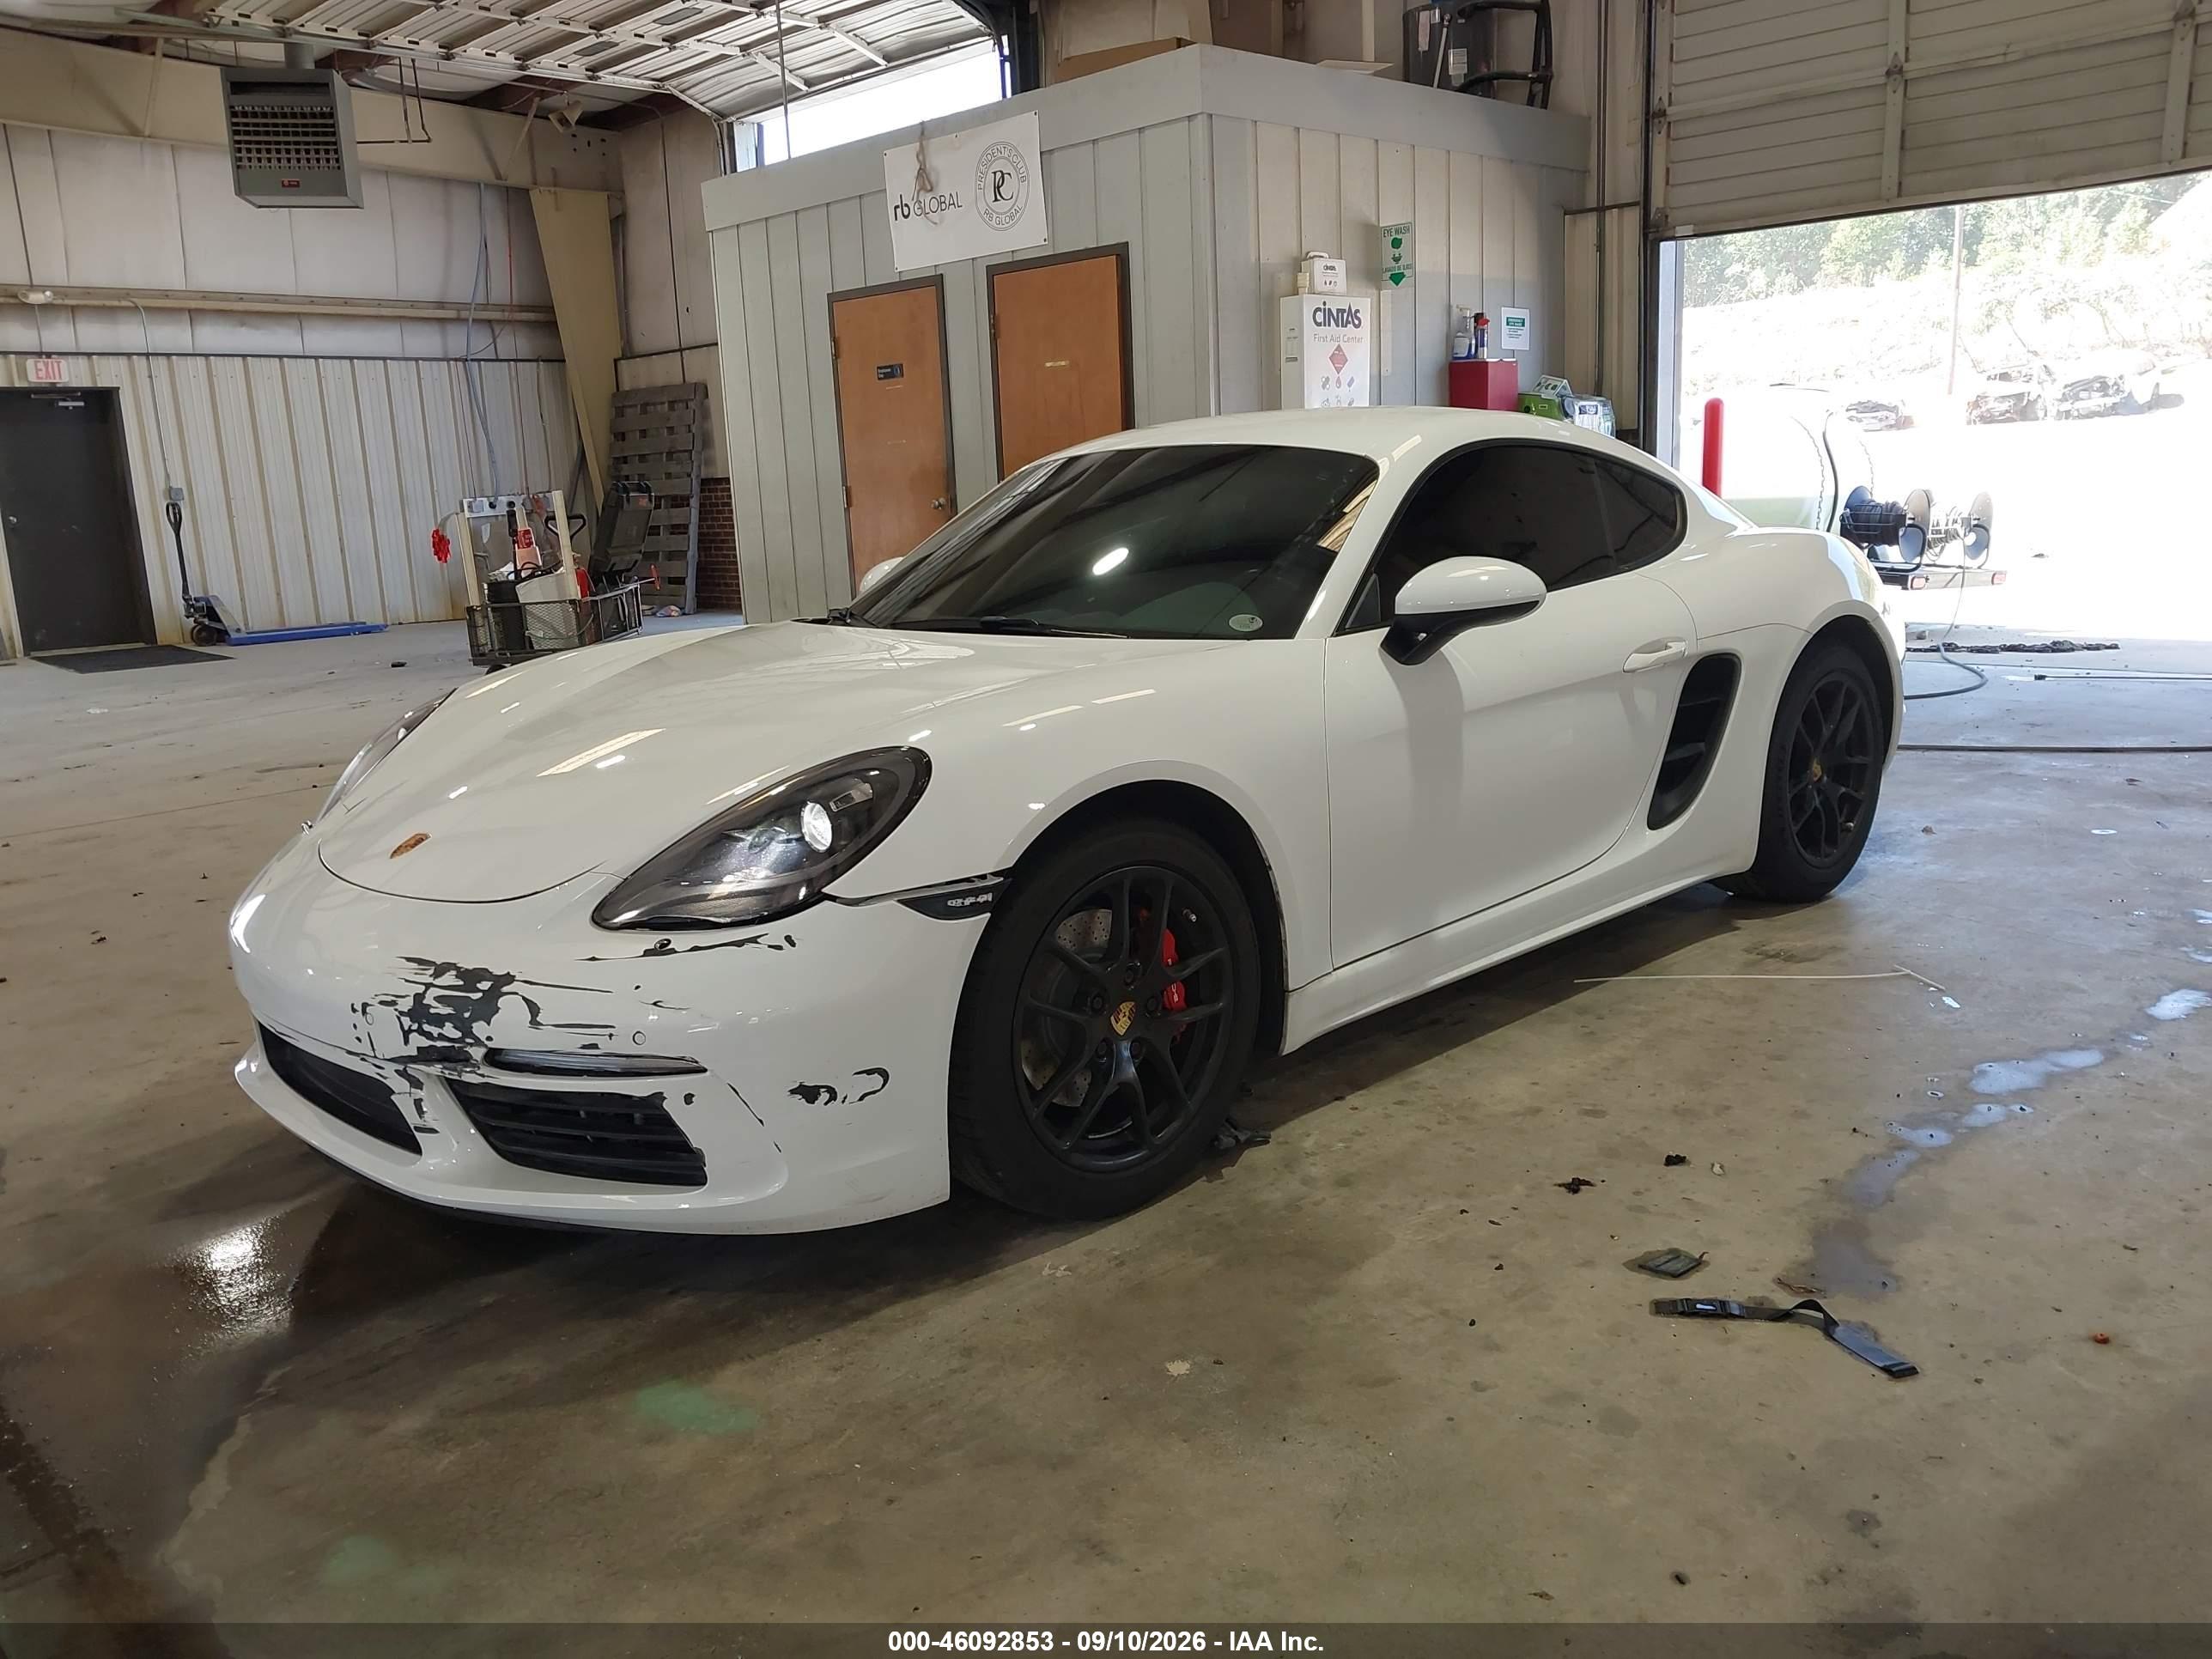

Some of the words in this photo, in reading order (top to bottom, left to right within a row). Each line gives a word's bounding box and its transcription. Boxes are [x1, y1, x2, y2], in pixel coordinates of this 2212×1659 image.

[978, 145, 1013, 191] PRESIDENT'S
[1012, 154, 1027, 184] CLUB
[893, 193, 911, 222] rb
[913, 191, 963, 217] GLOBAL
[983, 208, 994, 222] RB
[994, 204, 1024, 226] GLOBAL
[1383, 228, 1394, 238] EYE
[1395, 225, 1410, 235] WASH
[1313, 333, 1328, 343] First
[1329, 333, 1341, 343] Aid
[1342, 334, 1364, 344] Center
[33, 360, 64, 380] EXIT
